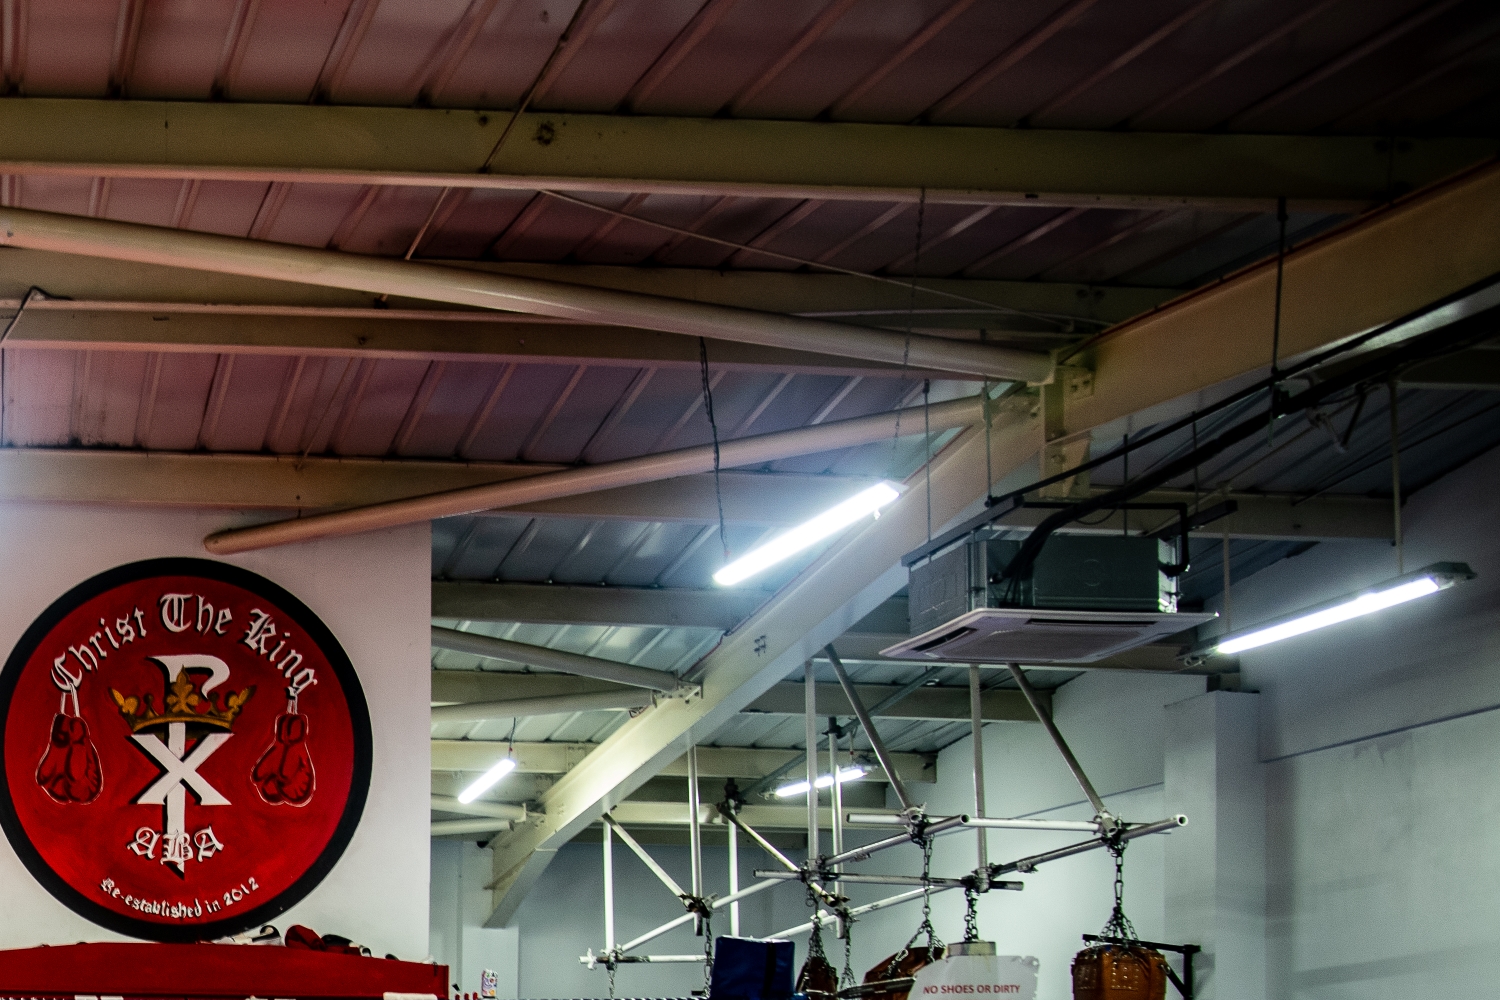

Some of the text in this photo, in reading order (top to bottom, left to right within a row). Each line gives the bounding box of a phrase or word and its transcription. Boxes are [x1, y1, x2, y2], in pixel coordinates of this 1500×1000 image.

[51, 593, 318, 700] Christ The King
[127, 825, 225, 866] ABA
[100, 876, 260, 918] Re-established in 2012
[922, 984, 1021, 995] NO SHOES OR DIRTY
